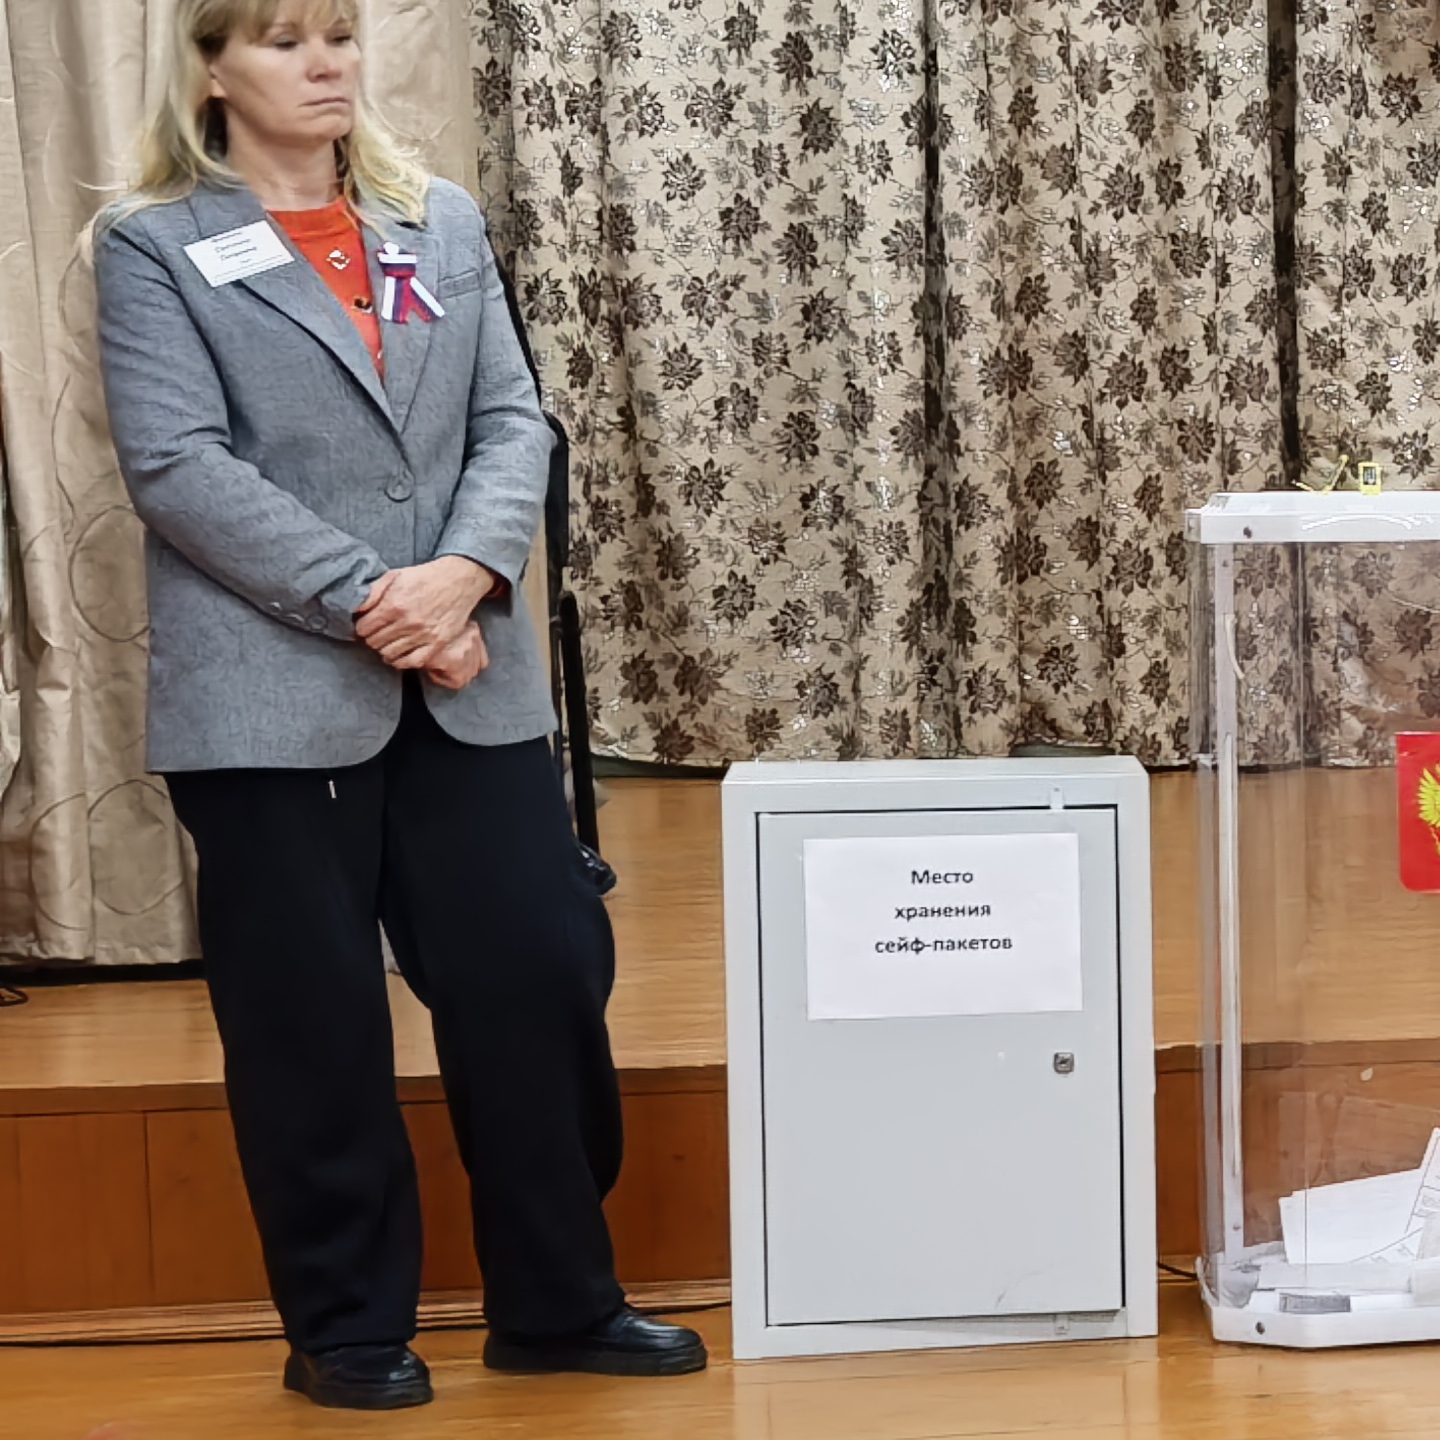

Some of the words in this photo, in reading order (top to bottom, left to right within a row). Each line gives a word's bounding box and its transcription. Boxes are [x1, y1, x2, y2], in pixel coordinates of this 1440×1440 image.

[911, 870, 974, 885] Место
[895, 904, 991, 923] хранения
[875, 937, 1013, 954] сейф-пакетов
